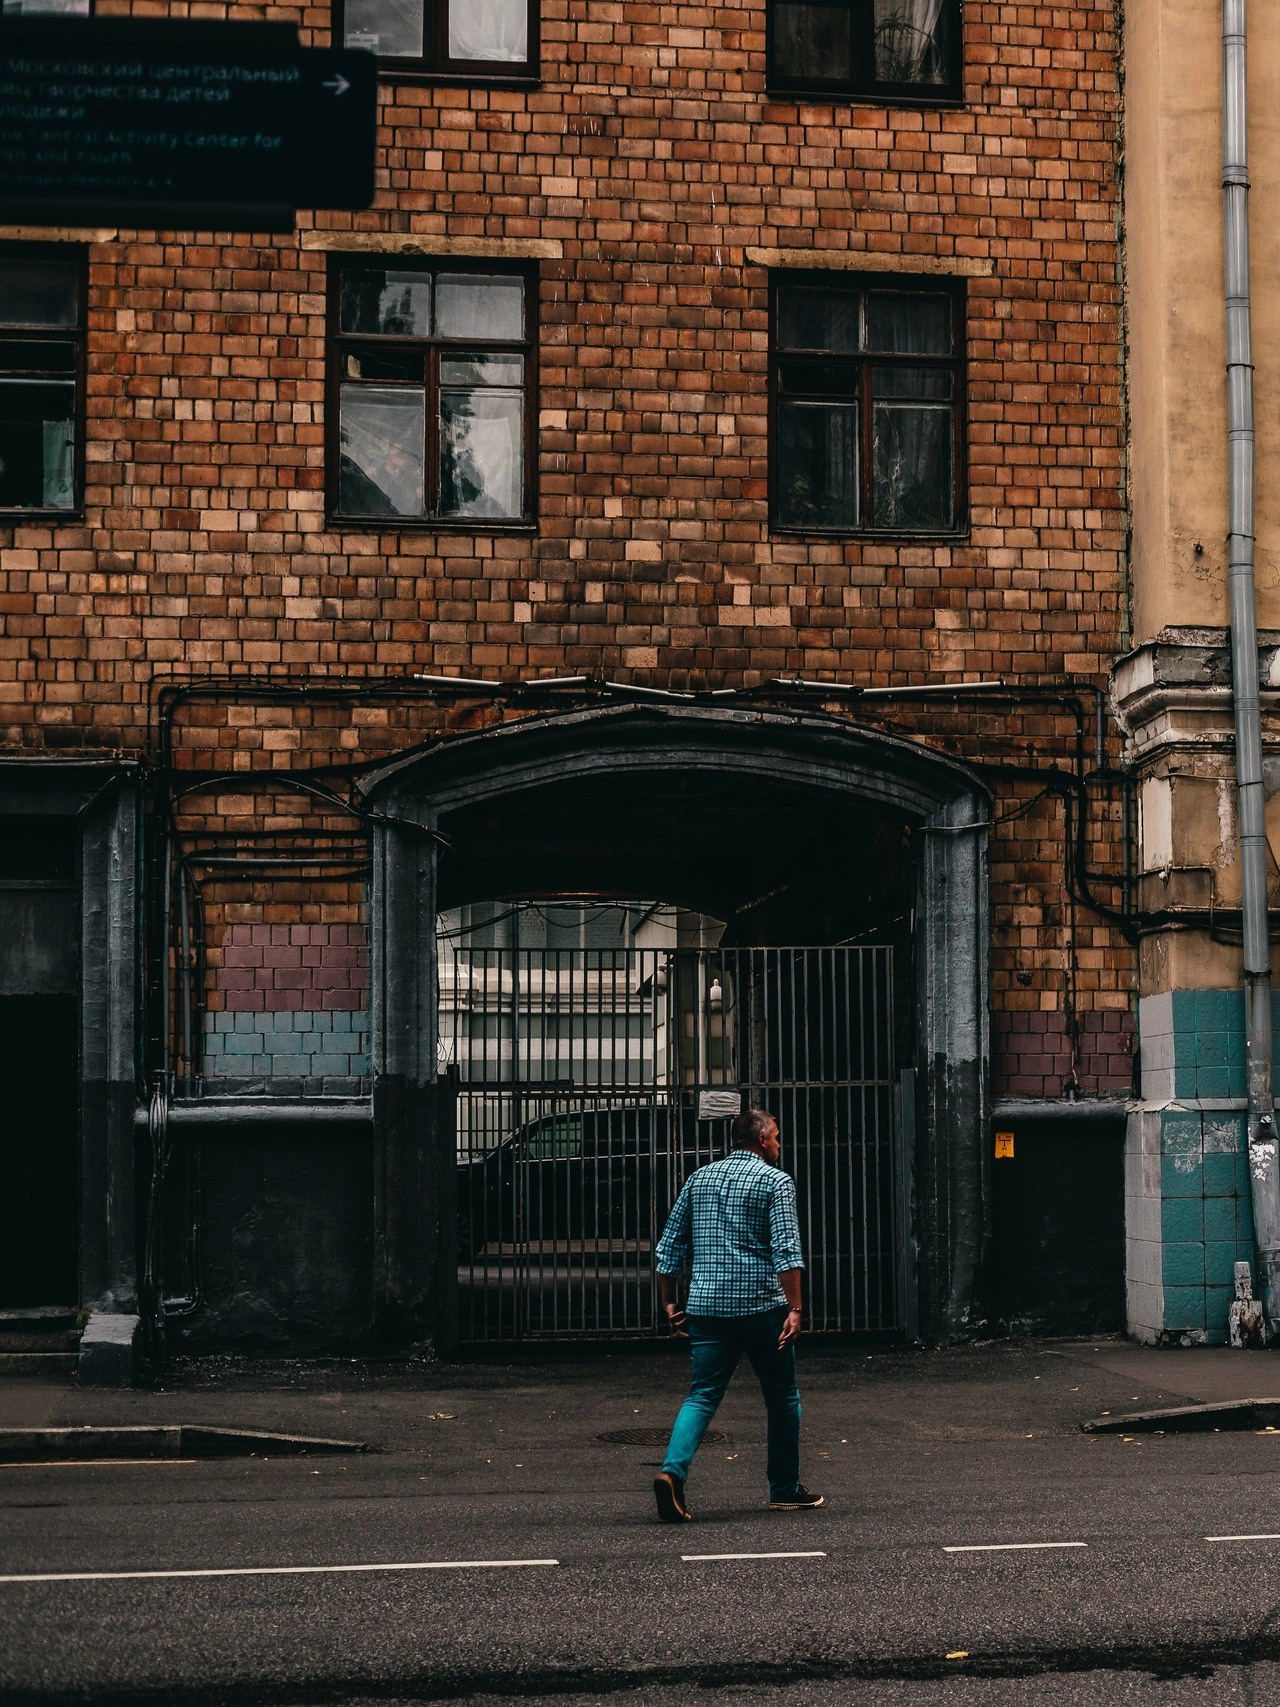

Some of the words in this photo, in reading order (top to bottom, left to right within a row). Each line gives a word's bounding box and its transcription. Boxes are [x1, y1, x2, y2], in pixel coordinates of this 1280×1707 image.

[148, 64, 299, 84] центральный
[164, 84, 231, 103] детей
[184, 131, 248, 148] Center
[254, 131, 282, 148] for
